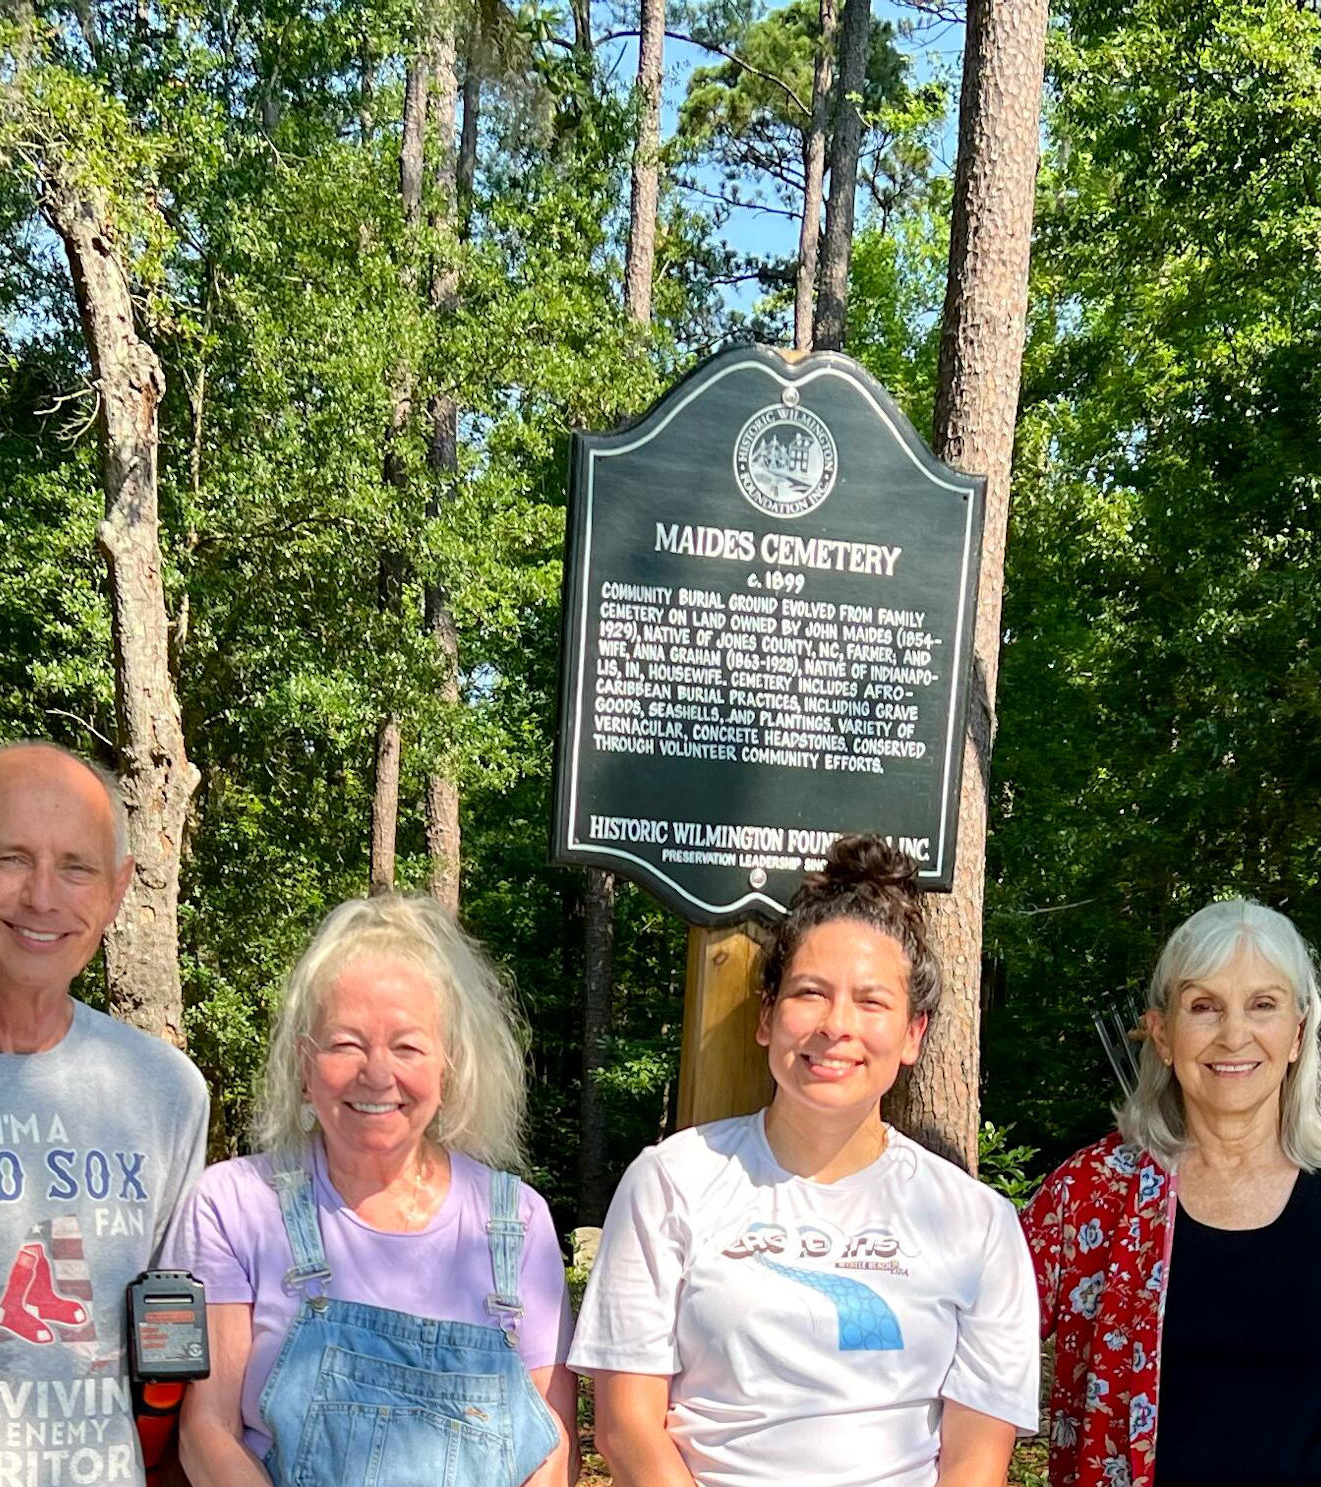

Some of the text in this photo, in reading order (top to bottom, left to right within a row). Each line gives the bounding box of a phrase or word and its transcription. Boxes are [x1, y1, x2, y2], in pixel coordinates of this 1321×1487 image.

[738, 409, 834, 471] HISTORIC WILMINGTON
[741, 472, 808, 513] FOUNDATION
[654, 522, 902, 577] MAIDES CEMETERY
[766, 570, 805, 594] 1899
[600, 602, 942, 649] CEMETERY ON LAND OWNED BY JOHN MAIDES (1854-
[601, 581, 925, 628] COMMUNITY BURIAL GROUND EVOLVED FROM FAMILY
[598, 639, 630, 659] WIFE,
[633, 643, 665, 662] ANNA
[670, 646, 721, 667] GRAHAM
[805, 659, 846, 677] NATIVE
[851, 664, 867, 679] OF
[871, 665, 938, 686] INDIANAPO-
[600, 620, 931, 666] 1929), NATIVE OF JONES COUNTY, NC, FARMER; AND
[595, 678, 918, 721] CARIBBEAN BURIAL PRACTICES, INCLUDING GRAVE
[597, 659, 914, 701] LIS, IN, HOUSEWIFE. CEMETERY INCLUDES AFRO-
[594, 714, 926, 759] VERNACULAR, CONCRETE HEADSTONES. CONSERVED
[595, 697, 915, 739] GOODS, SEASHELLS, AND PLANTINGS. VARIETY OF
[593, 734, 884, 774] THROUGH VOLUNTEER COMMUNITY EFFORTS.
[590, 815, 669, 844] HISTORIC
[672, 820, 784, 852] WILMINGTON
[662, 849, 737, 867] PRESERVATION
[740, 853, 801, 871] LEADERSHIP
[46, 1113, 69, 1143] A
[46, 1148, 148, 1202] SOX
[96, 1208, 144, 1236] FAN
[7, 1418, 110, 1447] ENEMY
